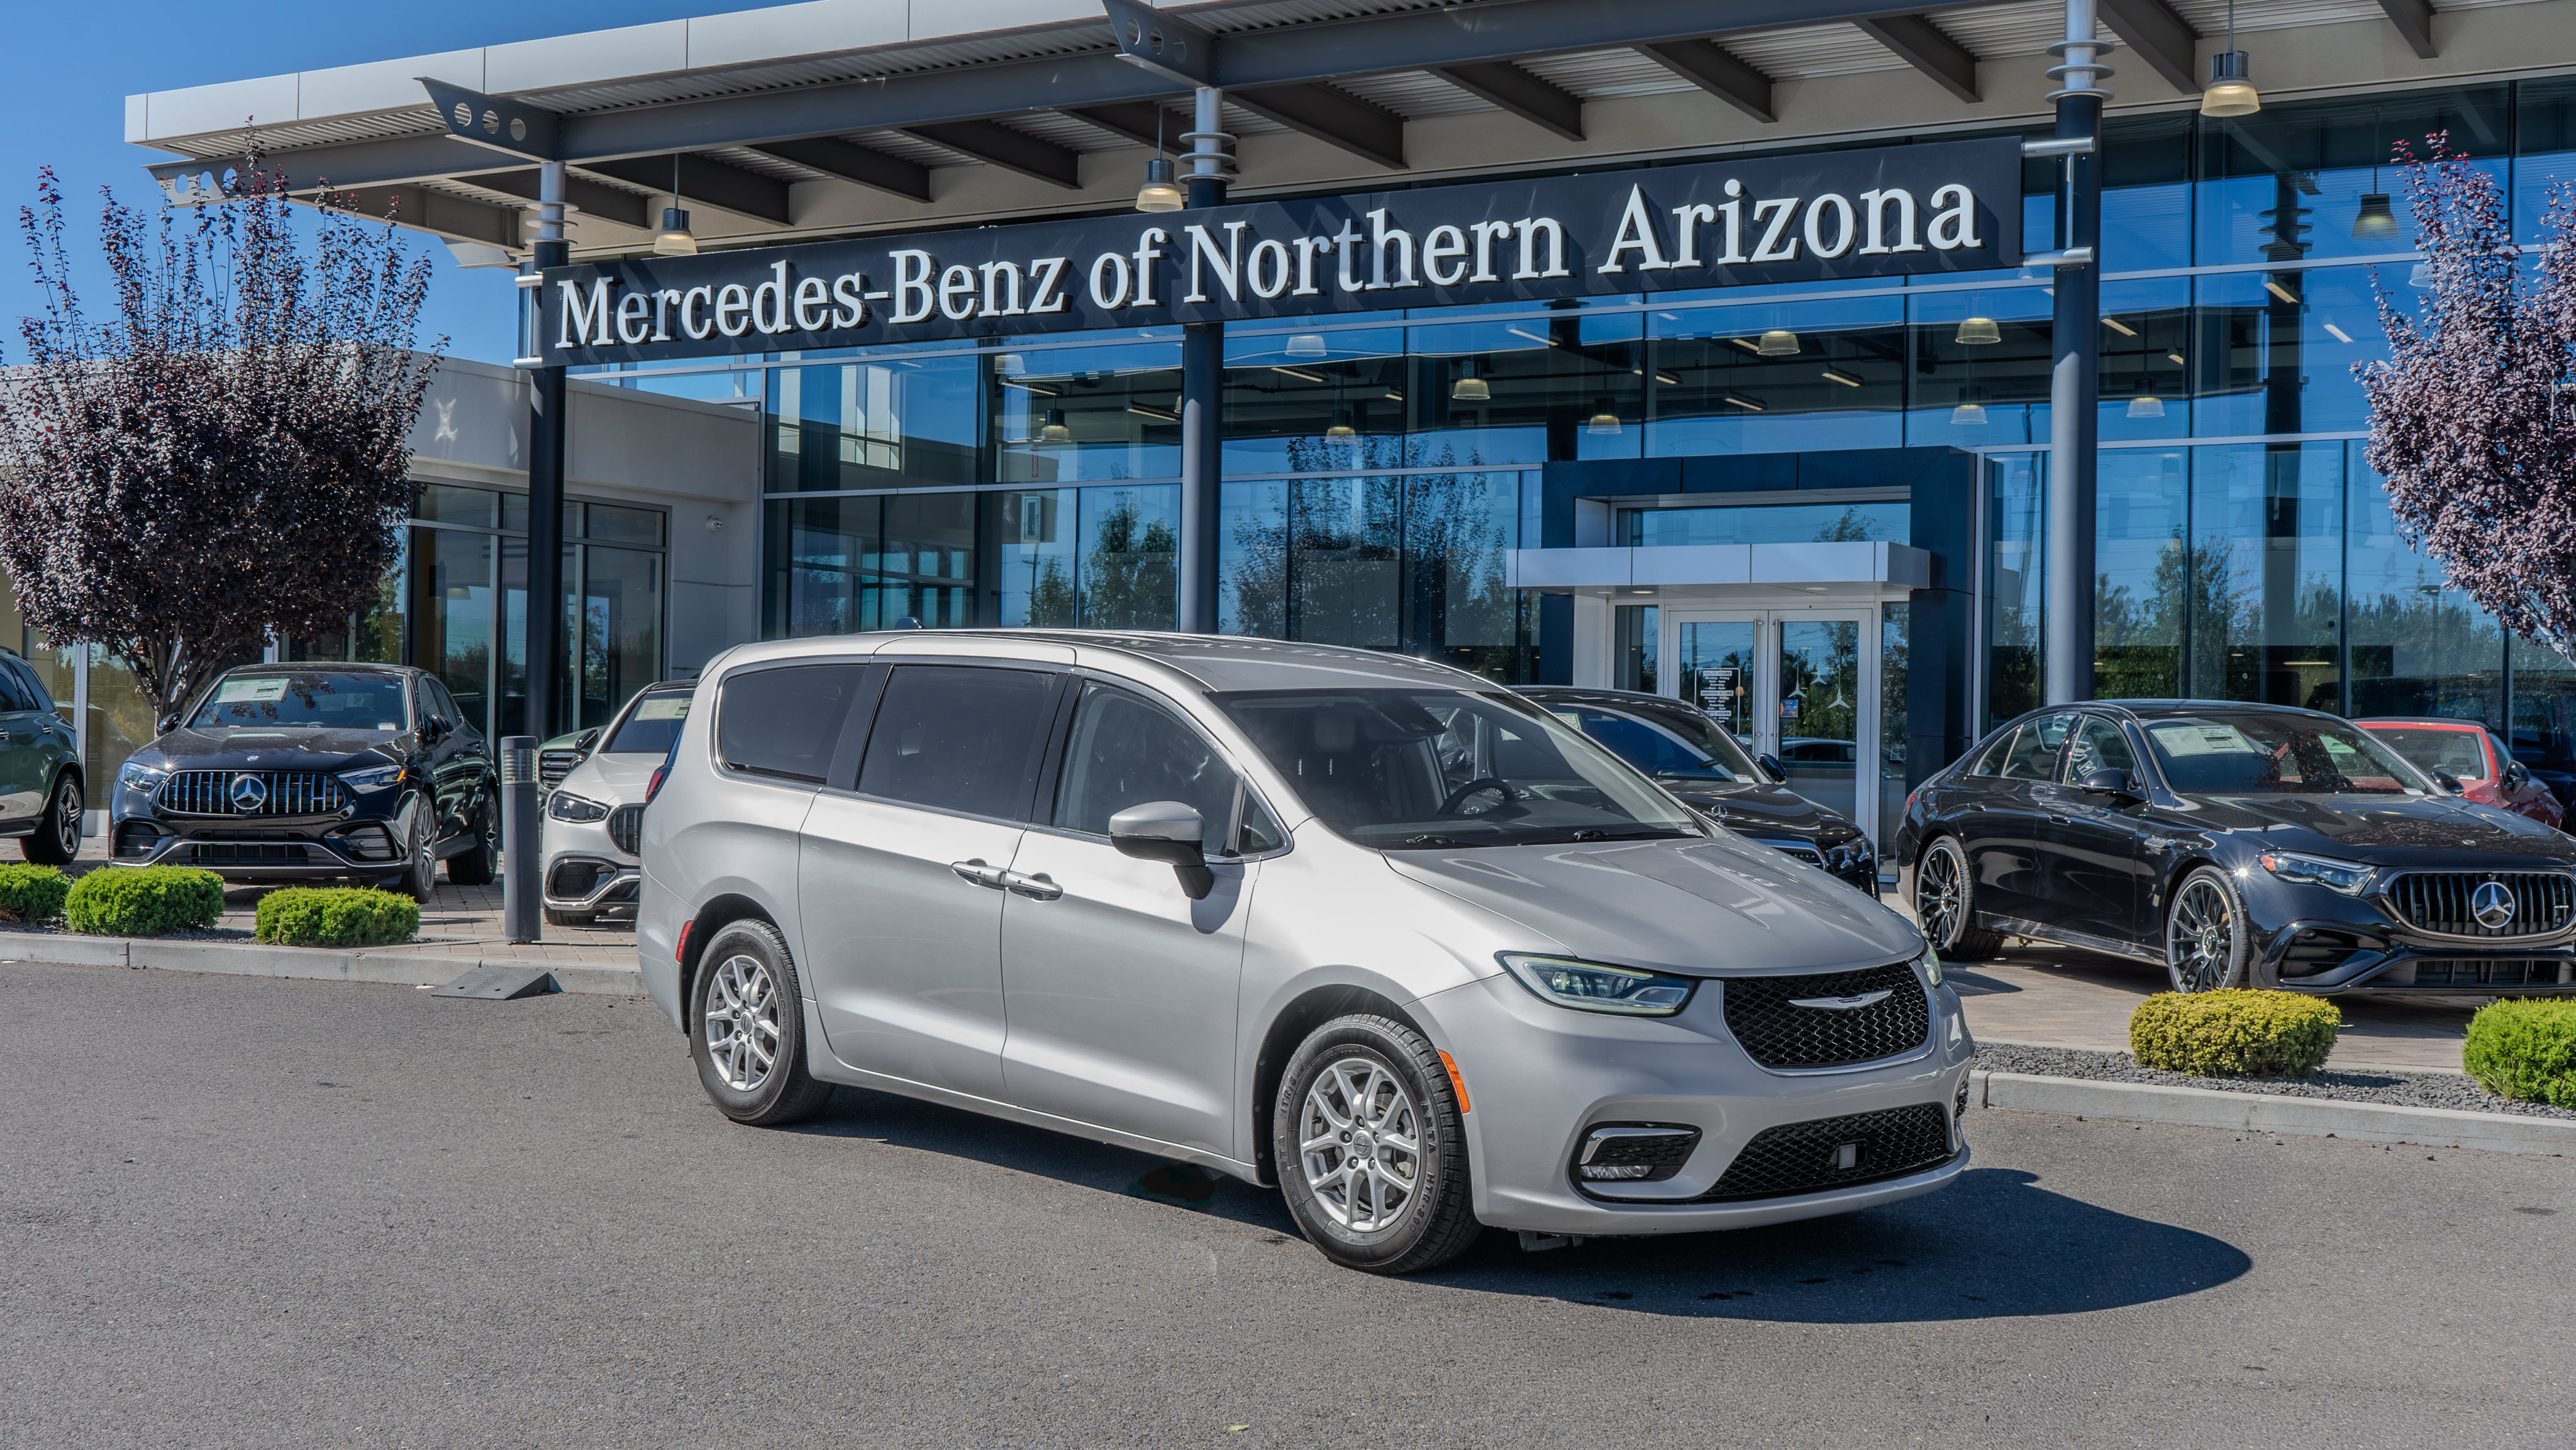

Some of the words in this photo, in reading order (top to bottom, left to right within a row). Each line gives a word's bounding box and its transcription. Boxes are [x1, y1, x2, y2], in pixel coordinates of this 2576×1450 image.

[555, 248, 1070, 349] Mercedes-Benz
[1089, 227, 1171, 310] of
[1184, 208, 1571, 303] Northern
[1597, 178, 1982, 274] Arizona
